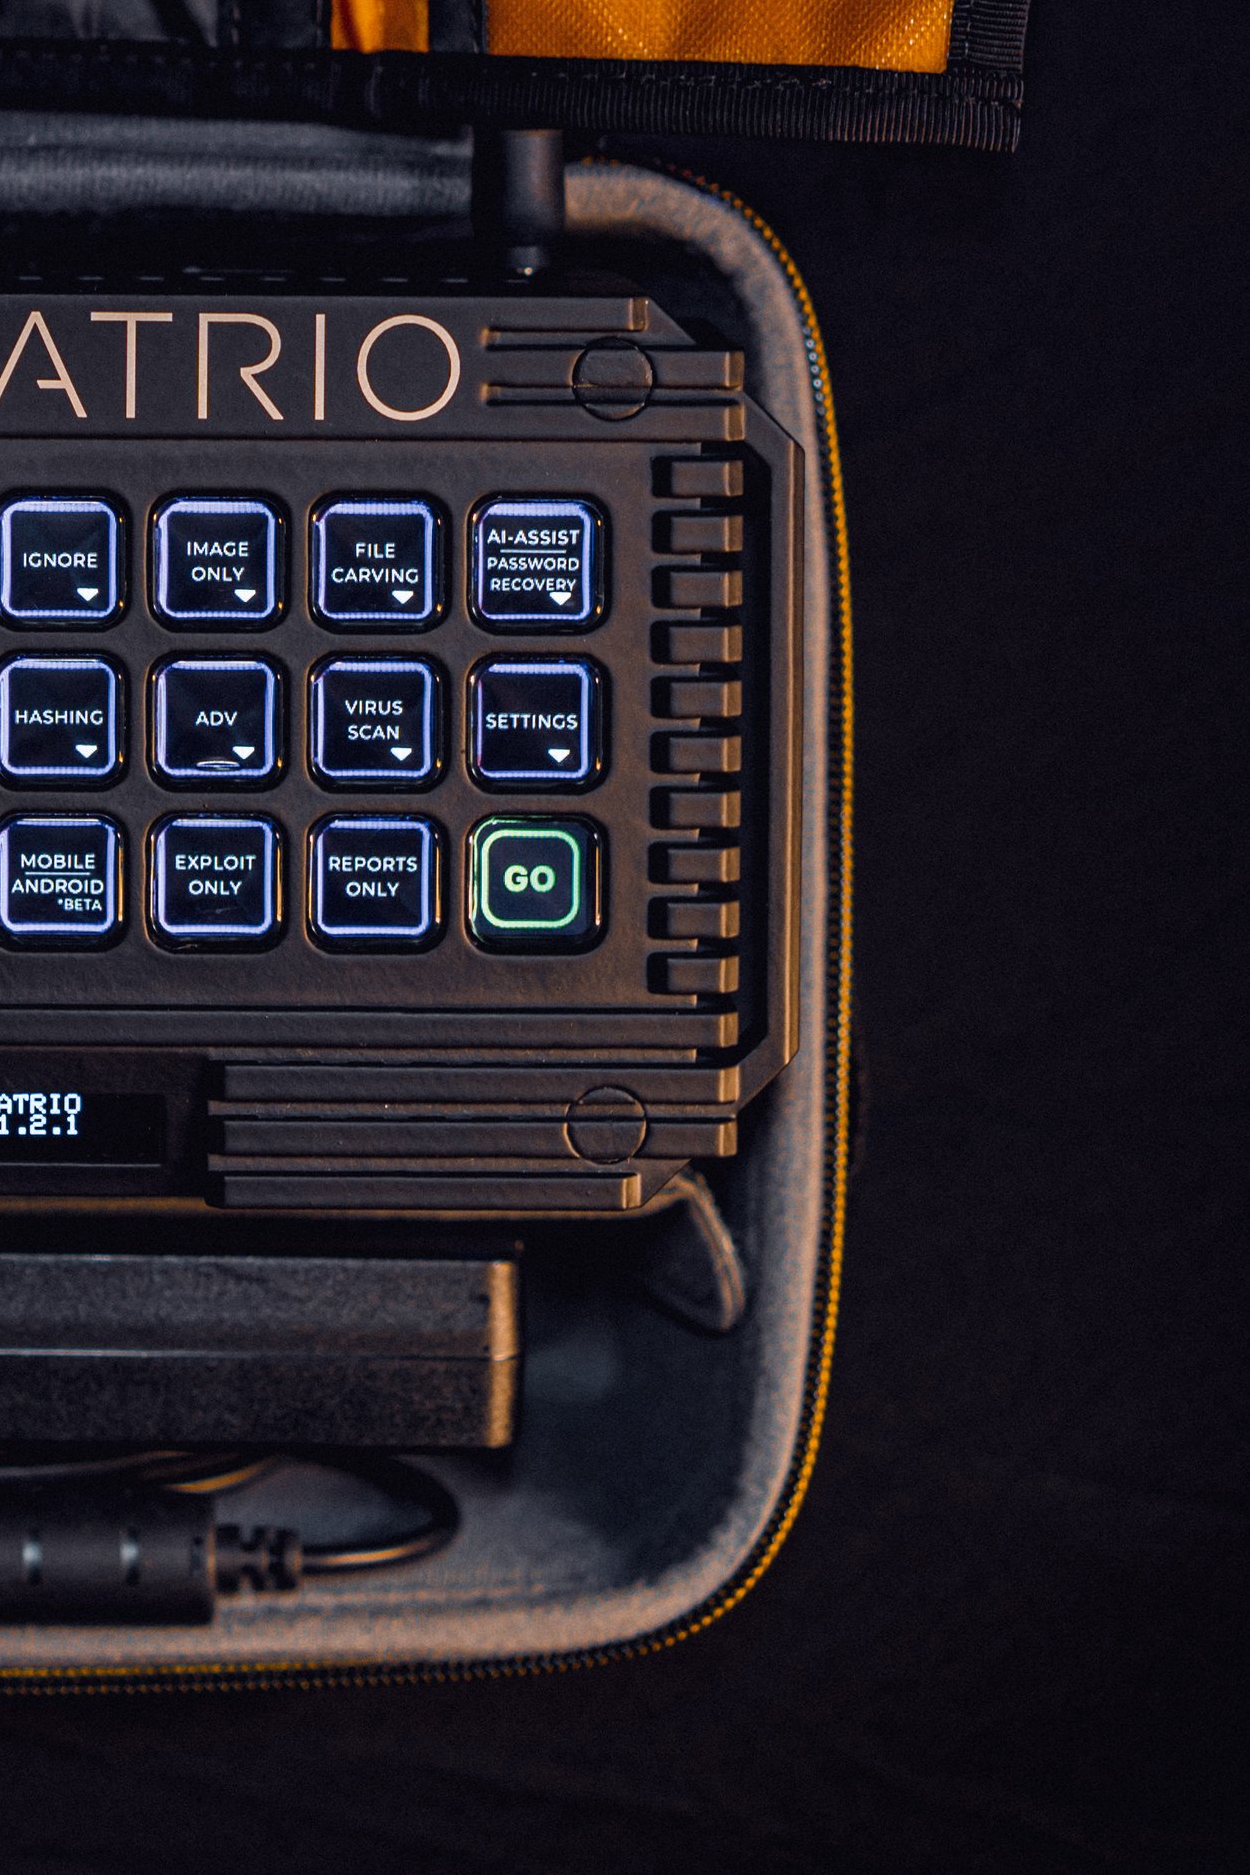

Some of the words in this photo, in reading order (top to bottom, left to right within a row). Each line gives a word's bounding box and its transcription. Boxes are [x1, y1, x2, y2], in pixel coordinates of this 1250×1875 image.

[486, 528, 580, 546] AI-ASSIST
[186, 540, 249, 558] IMAGE
[355, 541, 396, 559] FILE
[22, 552, 98, 569] IGNORE
[487, 556, 580, 572] PASSWORD
[190, 566, 245, 583] ONLY
[330, 566, 419, 585] CARVING
[489, 577, 576, 592] RECOVERY
[344, 699, 403, 716] VIRUS
[14, 709, 104, 726] HASHING
[195, 710, 238, 727] ADV
[485, 712, 578, 731] SETTINGS
[347, 724, 400, 741] SCAN
[20, 853, 96, 870] MOBILE
[174, 854, 257, 872] EXPLOIT
[328, 856, 418, 873] REPORTS
[11, 878, 105, 895] ANDROID
[503, 864, 556, 893] GO
[187, 879, 243, 896] ONLY
[344, 881, 400, 898] ONLY
